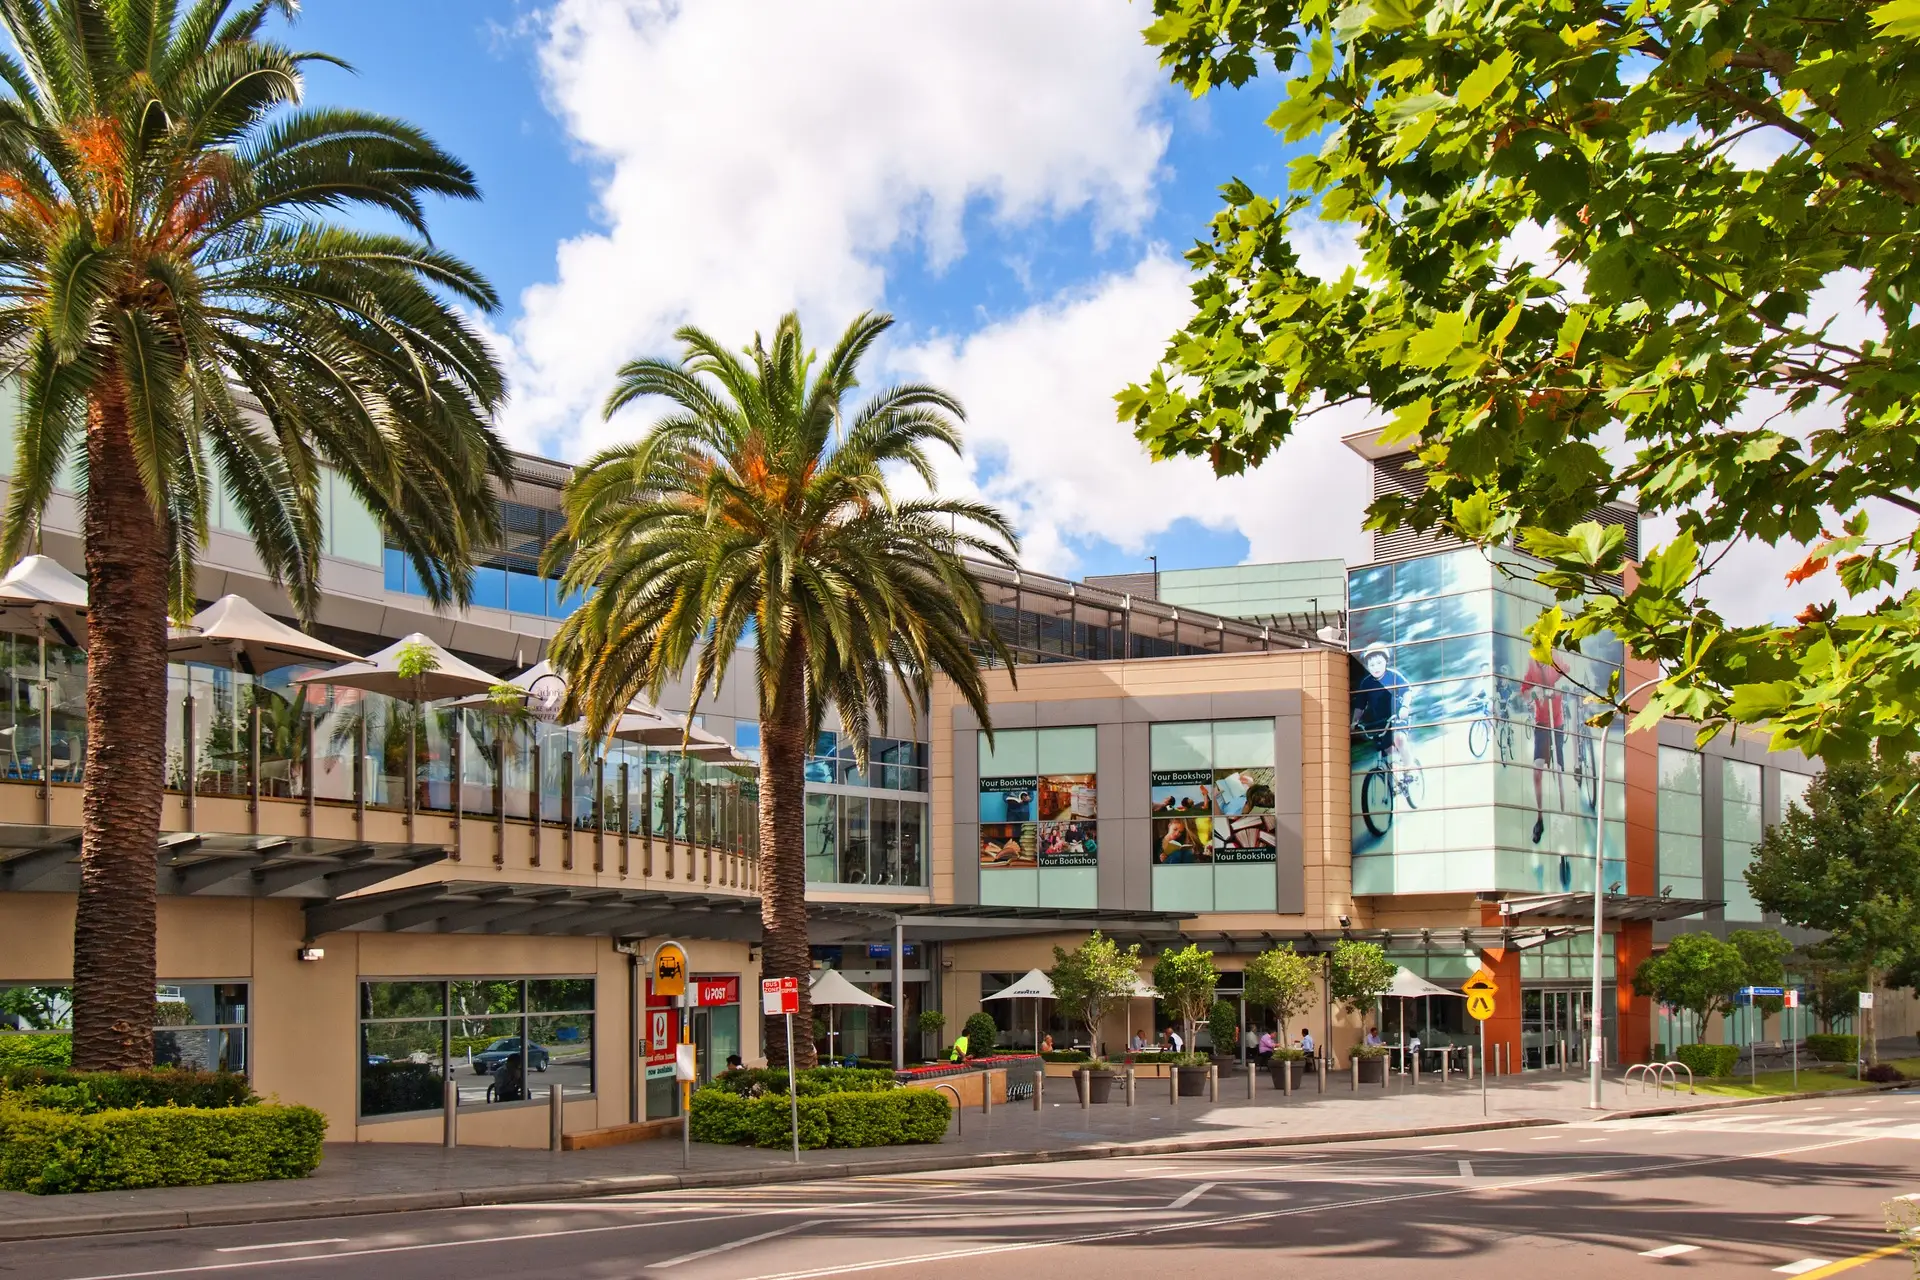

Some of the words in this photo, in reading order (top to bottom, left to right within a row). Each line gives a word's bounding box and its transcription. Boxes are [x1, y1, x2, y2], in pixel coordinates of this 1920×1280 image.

[1152, 773, 1171, 781] Your
[1172, 771, 1212, 780] Bookshop
[1000, 778, 1037, 787] Bookshop
[1059, 856, 1097, 865] Bookshop
[1216, 853, 1235, 861] Your
[1236, 852, 1277, 861] Bookshop
[710, 987, 726, 999] POST
